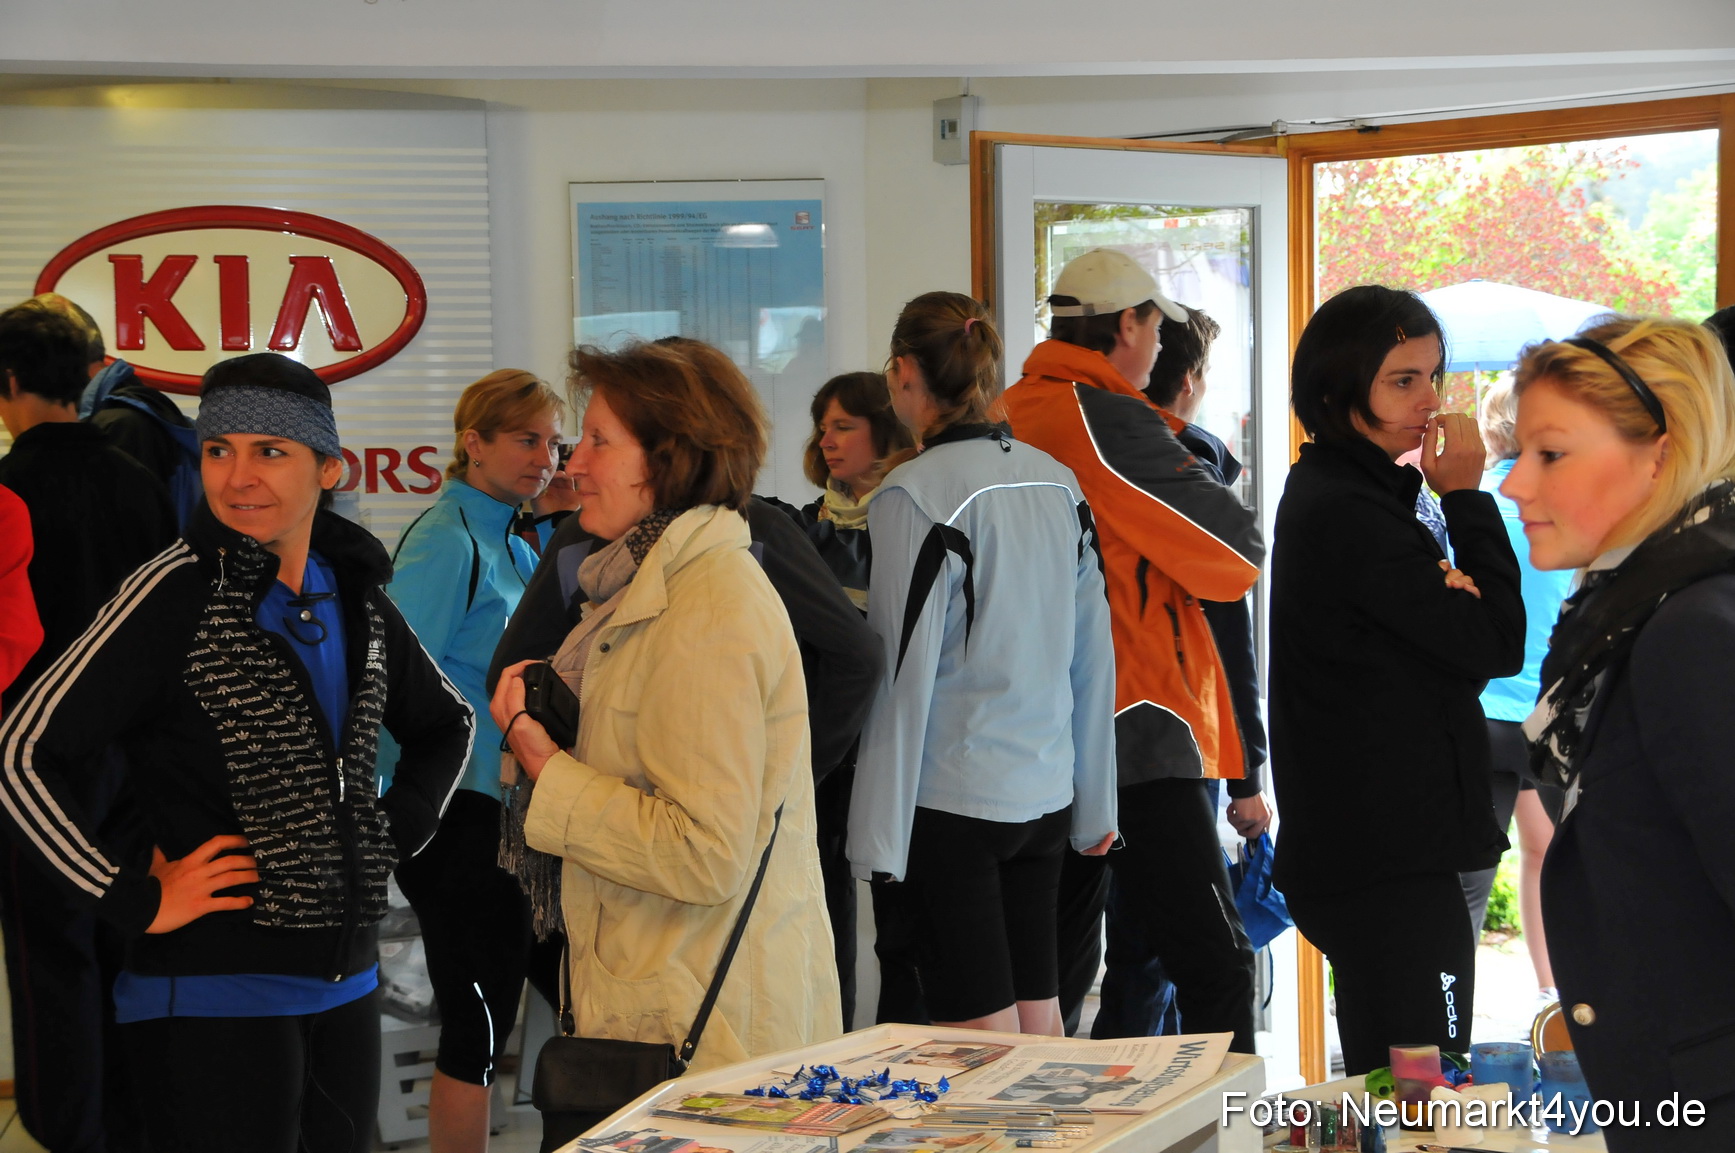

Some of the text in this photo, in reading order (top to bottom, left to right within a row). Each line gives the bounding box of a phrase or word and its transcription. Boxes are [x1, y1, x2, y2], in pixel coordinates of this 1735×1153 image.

[108, 254, 364, 352] KIA
[189, 648, 211, 657] adidas
[217, 671, 238, 679] adidas
[230, 683, 252, 692] adidas
[242, 695, 262, 704] adidas
[254, 707, 275, 716] adidas
[285, 807, 305, 817] adidas
[298, 819, 318, 827] adidas
[267, 846, 288, 855] adidas
[280, 859, 300, 867] adidas
[1445, 990, 1458, 1039] odlo
